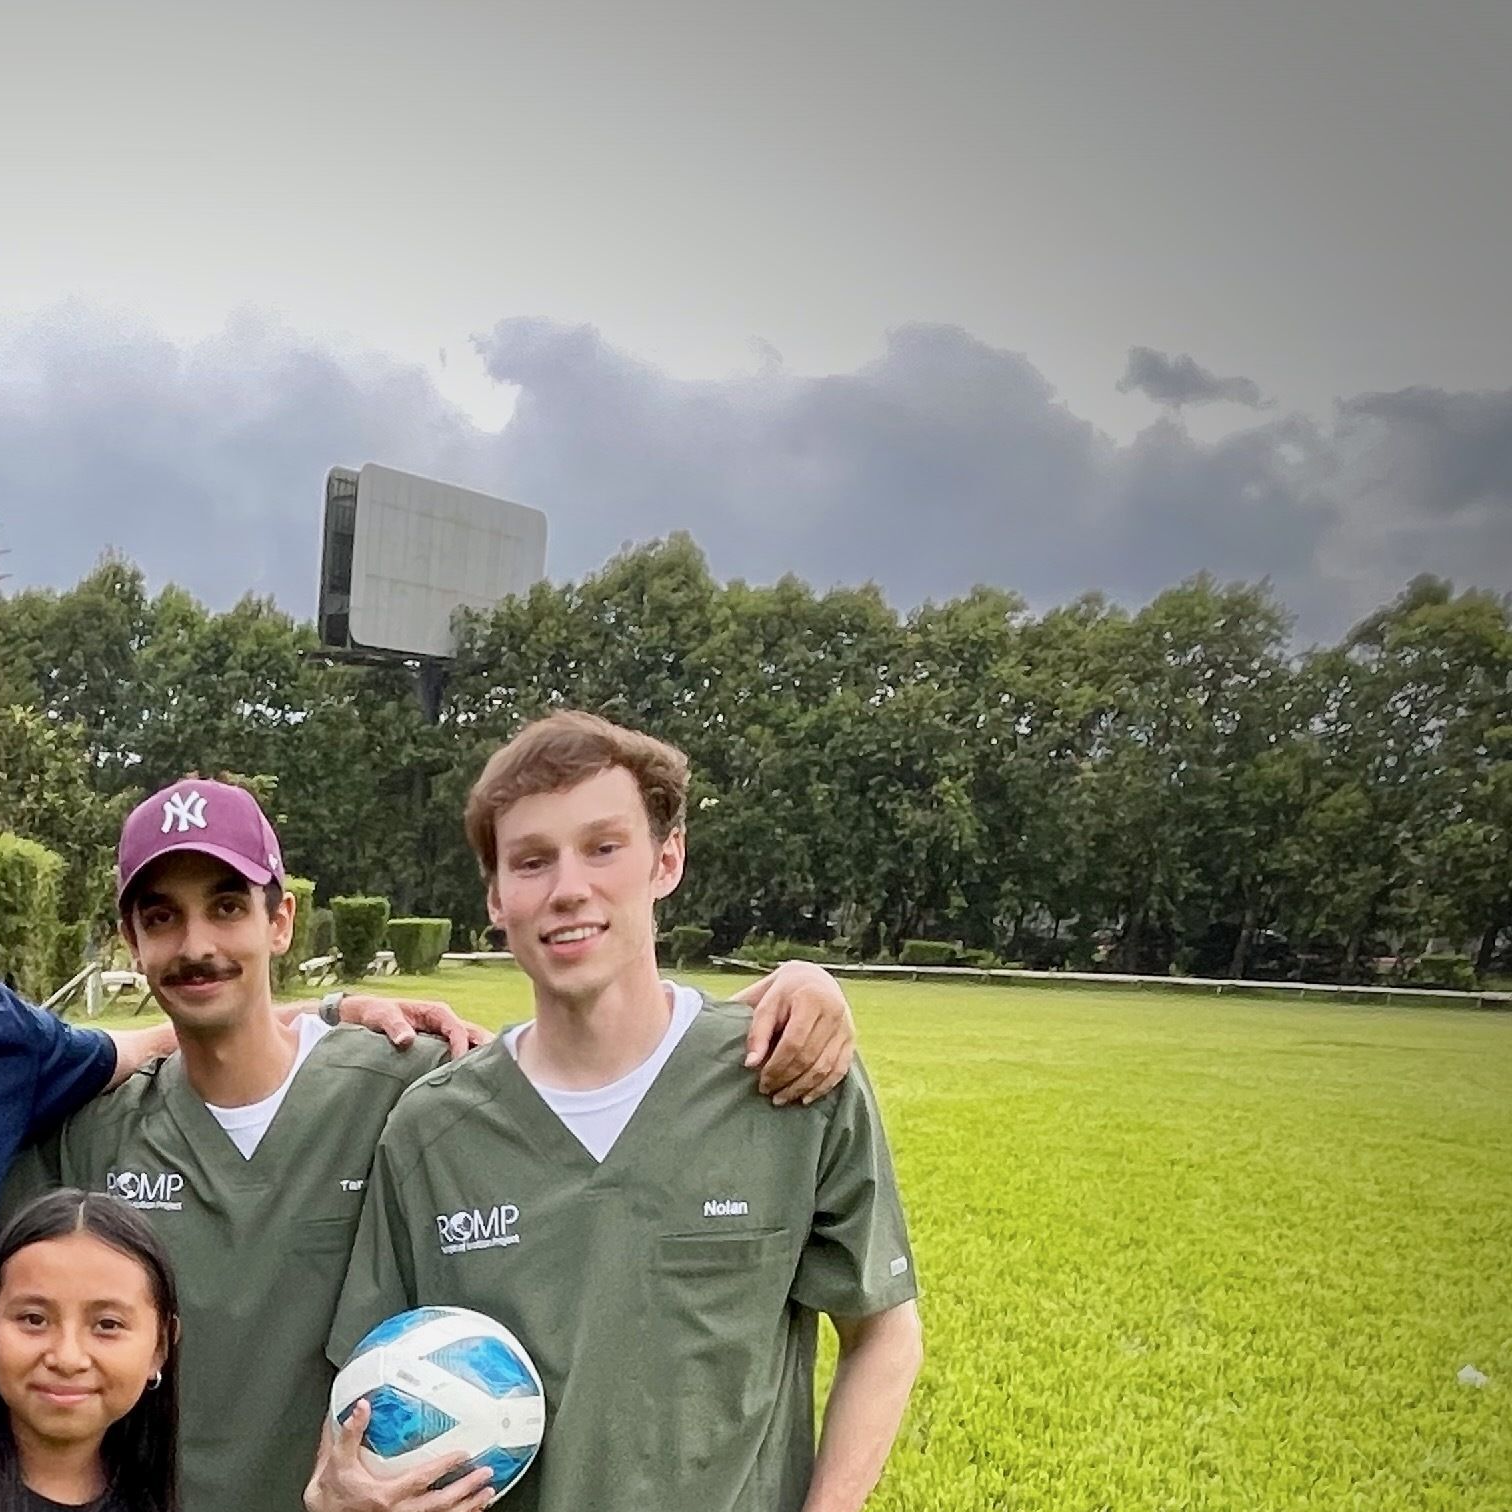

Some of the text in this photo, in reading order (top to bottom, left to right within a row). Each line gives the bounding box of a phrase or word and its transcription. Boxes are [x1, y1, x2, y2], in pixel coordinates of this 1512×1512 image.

[161, 790, 208, 834] NY
[436, 1204, 520, 1243] ROMP
[703, 1199, 748, 1217] Nolan
